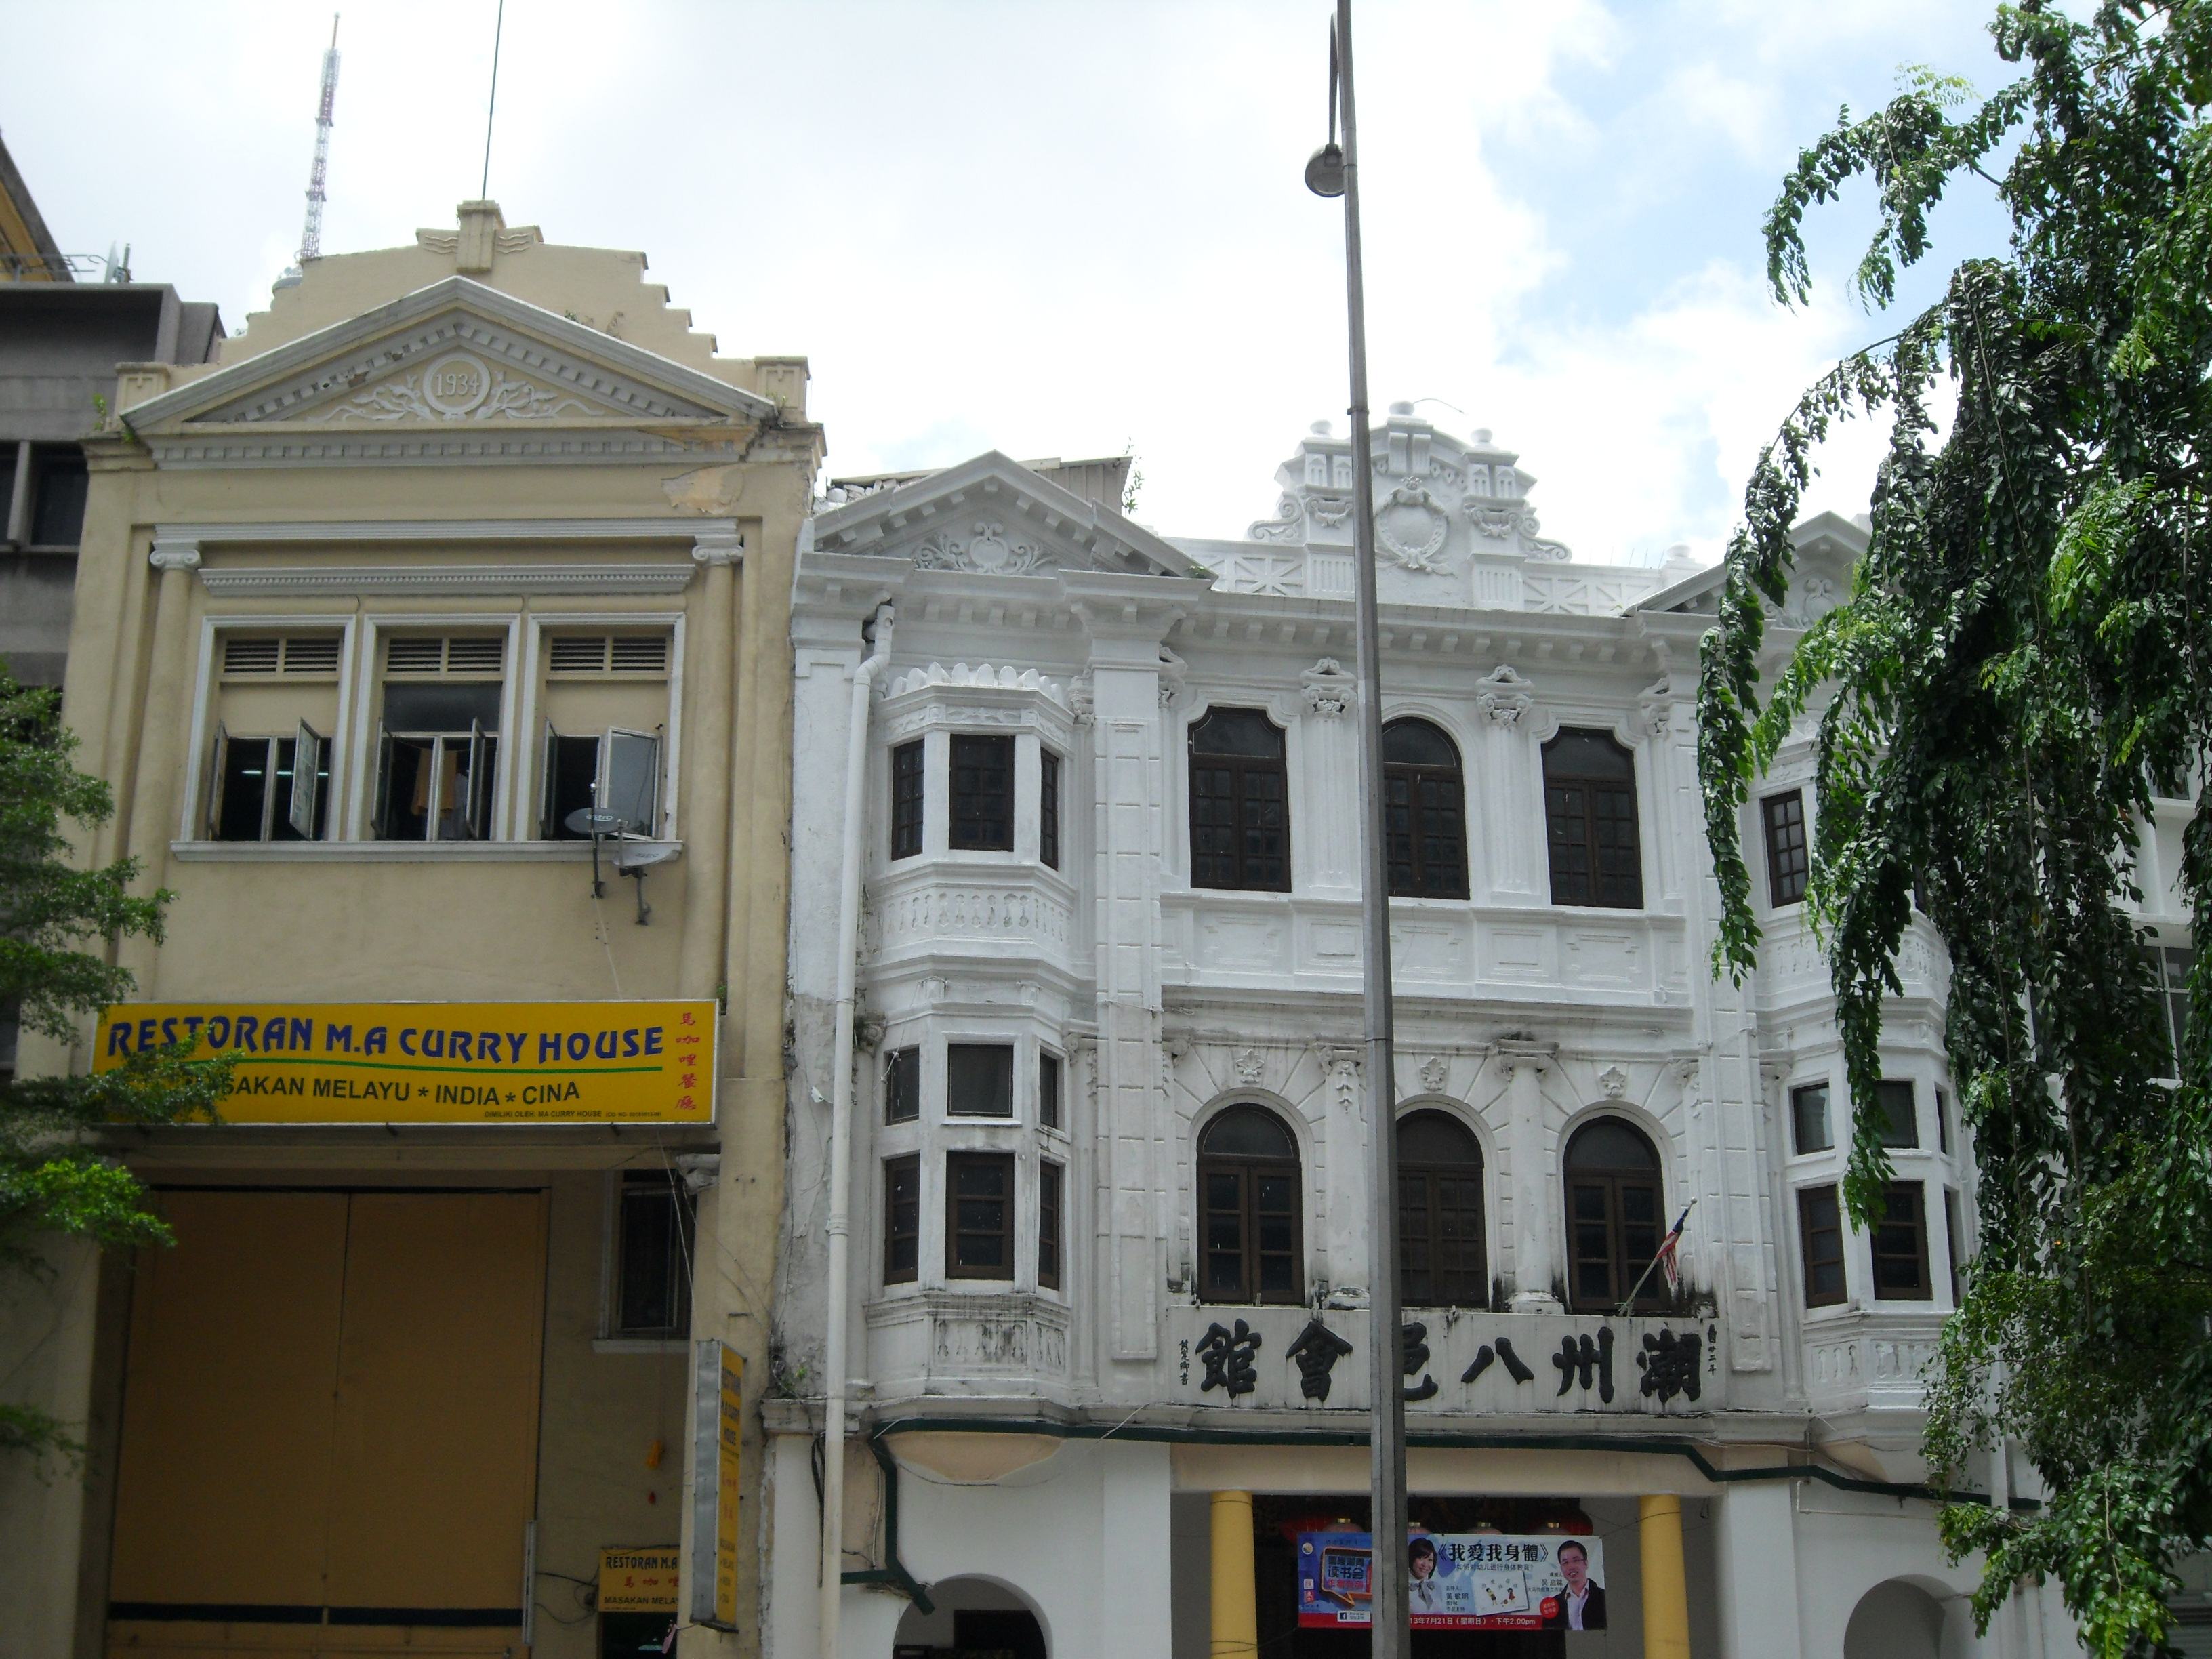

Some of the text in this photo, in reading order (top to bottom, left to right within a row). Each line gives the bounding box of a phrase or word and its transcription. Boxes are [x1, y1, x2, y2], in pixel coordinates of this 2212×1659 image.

[436, 372, 480, 398] 1934
[107, 1015, 664, 1065] RESTORAN M.A CURRY HOUSE
[312, 1078, 410, 1101] MELAYU
[435, 1085, 500, 1106] INDIA
[521, 1081, 581, 1105] CINA
[550, 1110, 575, 1118] CURRY
[576, 1110, 602, 1118] HOUSE
[1438, 1542, 1549, 1562] 《我愛我身體》
[606, 1556, 658, 1570] RESTORAN
[604, 1596, 649, 1604] MASAKAN
